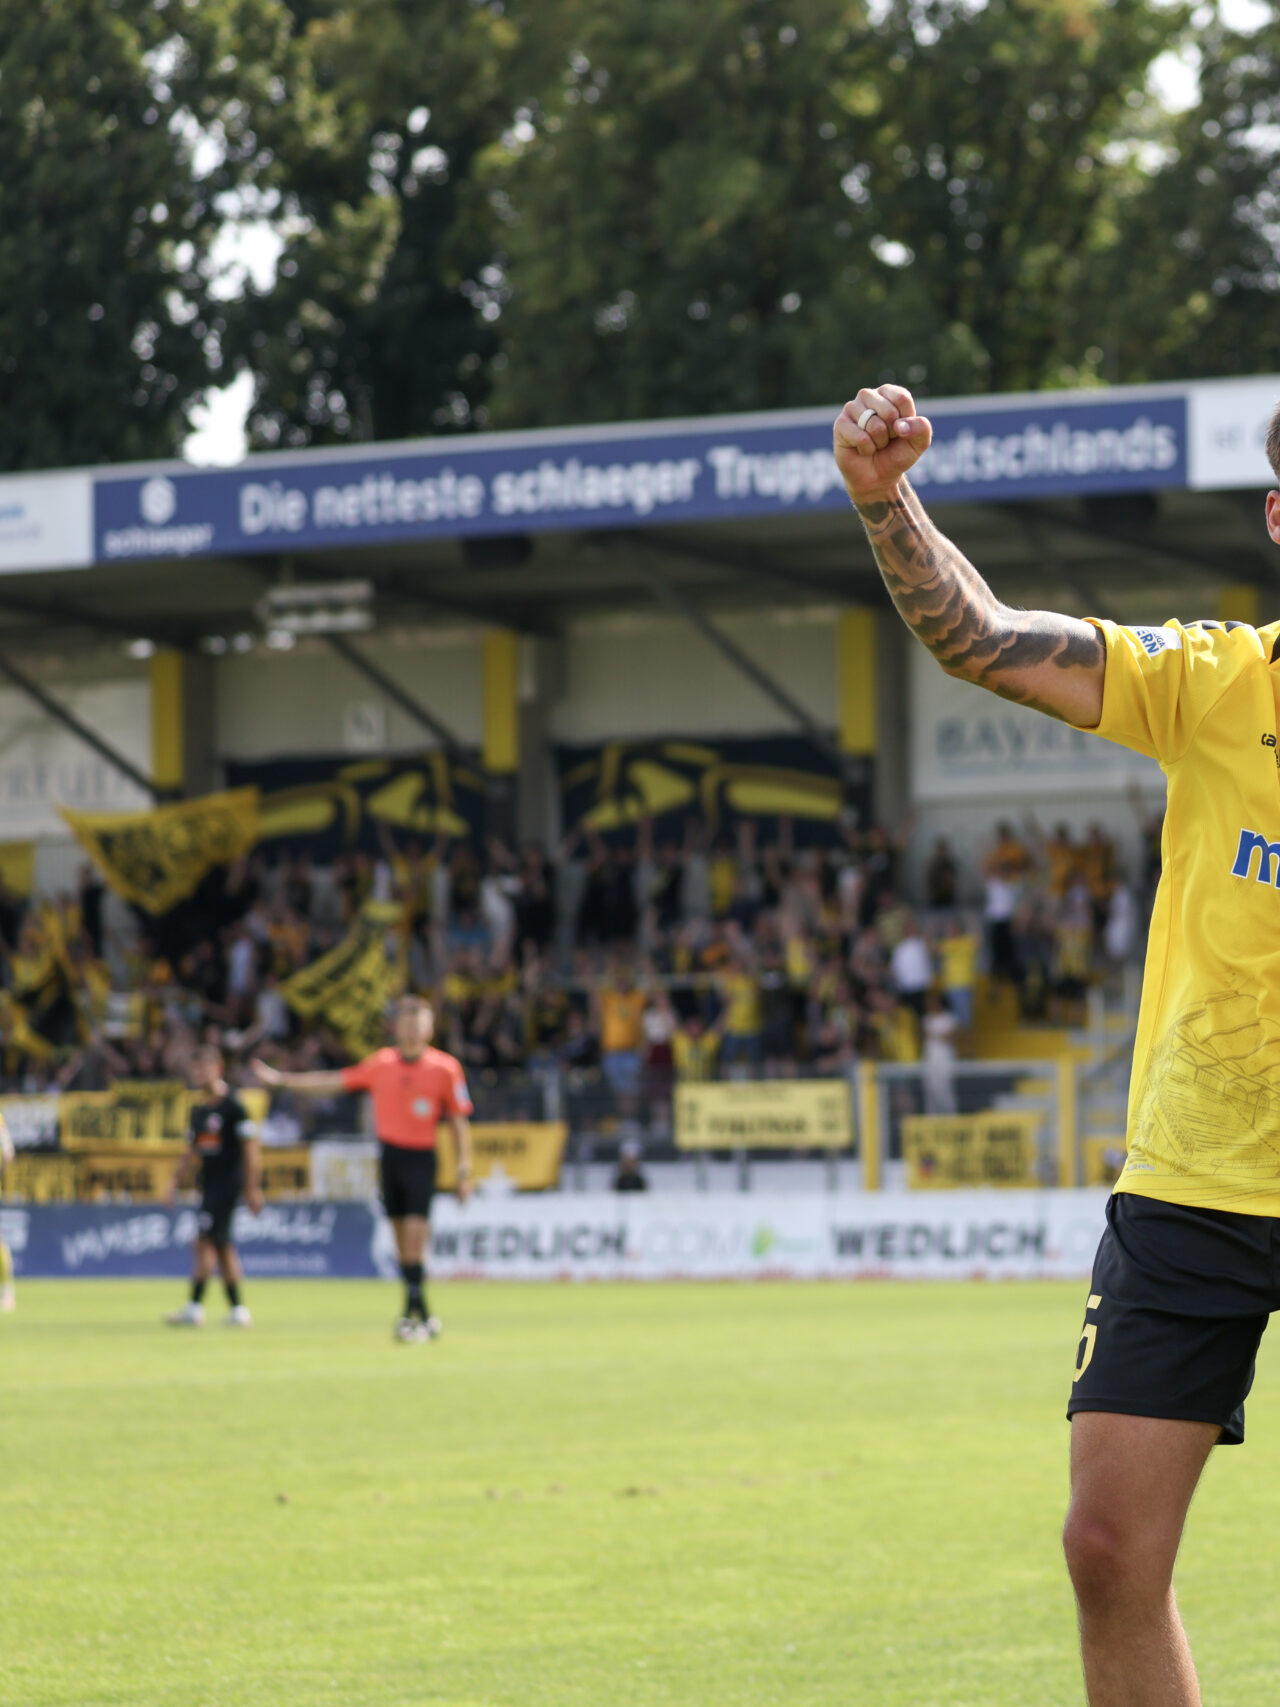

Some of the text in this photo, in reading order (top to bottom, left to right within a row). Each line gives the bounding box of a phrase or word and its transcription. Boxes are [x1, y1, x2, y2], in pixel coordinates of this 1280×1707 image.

[239, 483, 306, 534] Die
[314, 472, 483, 528] netteste
[492, 457, 698, 514] schlaeger
